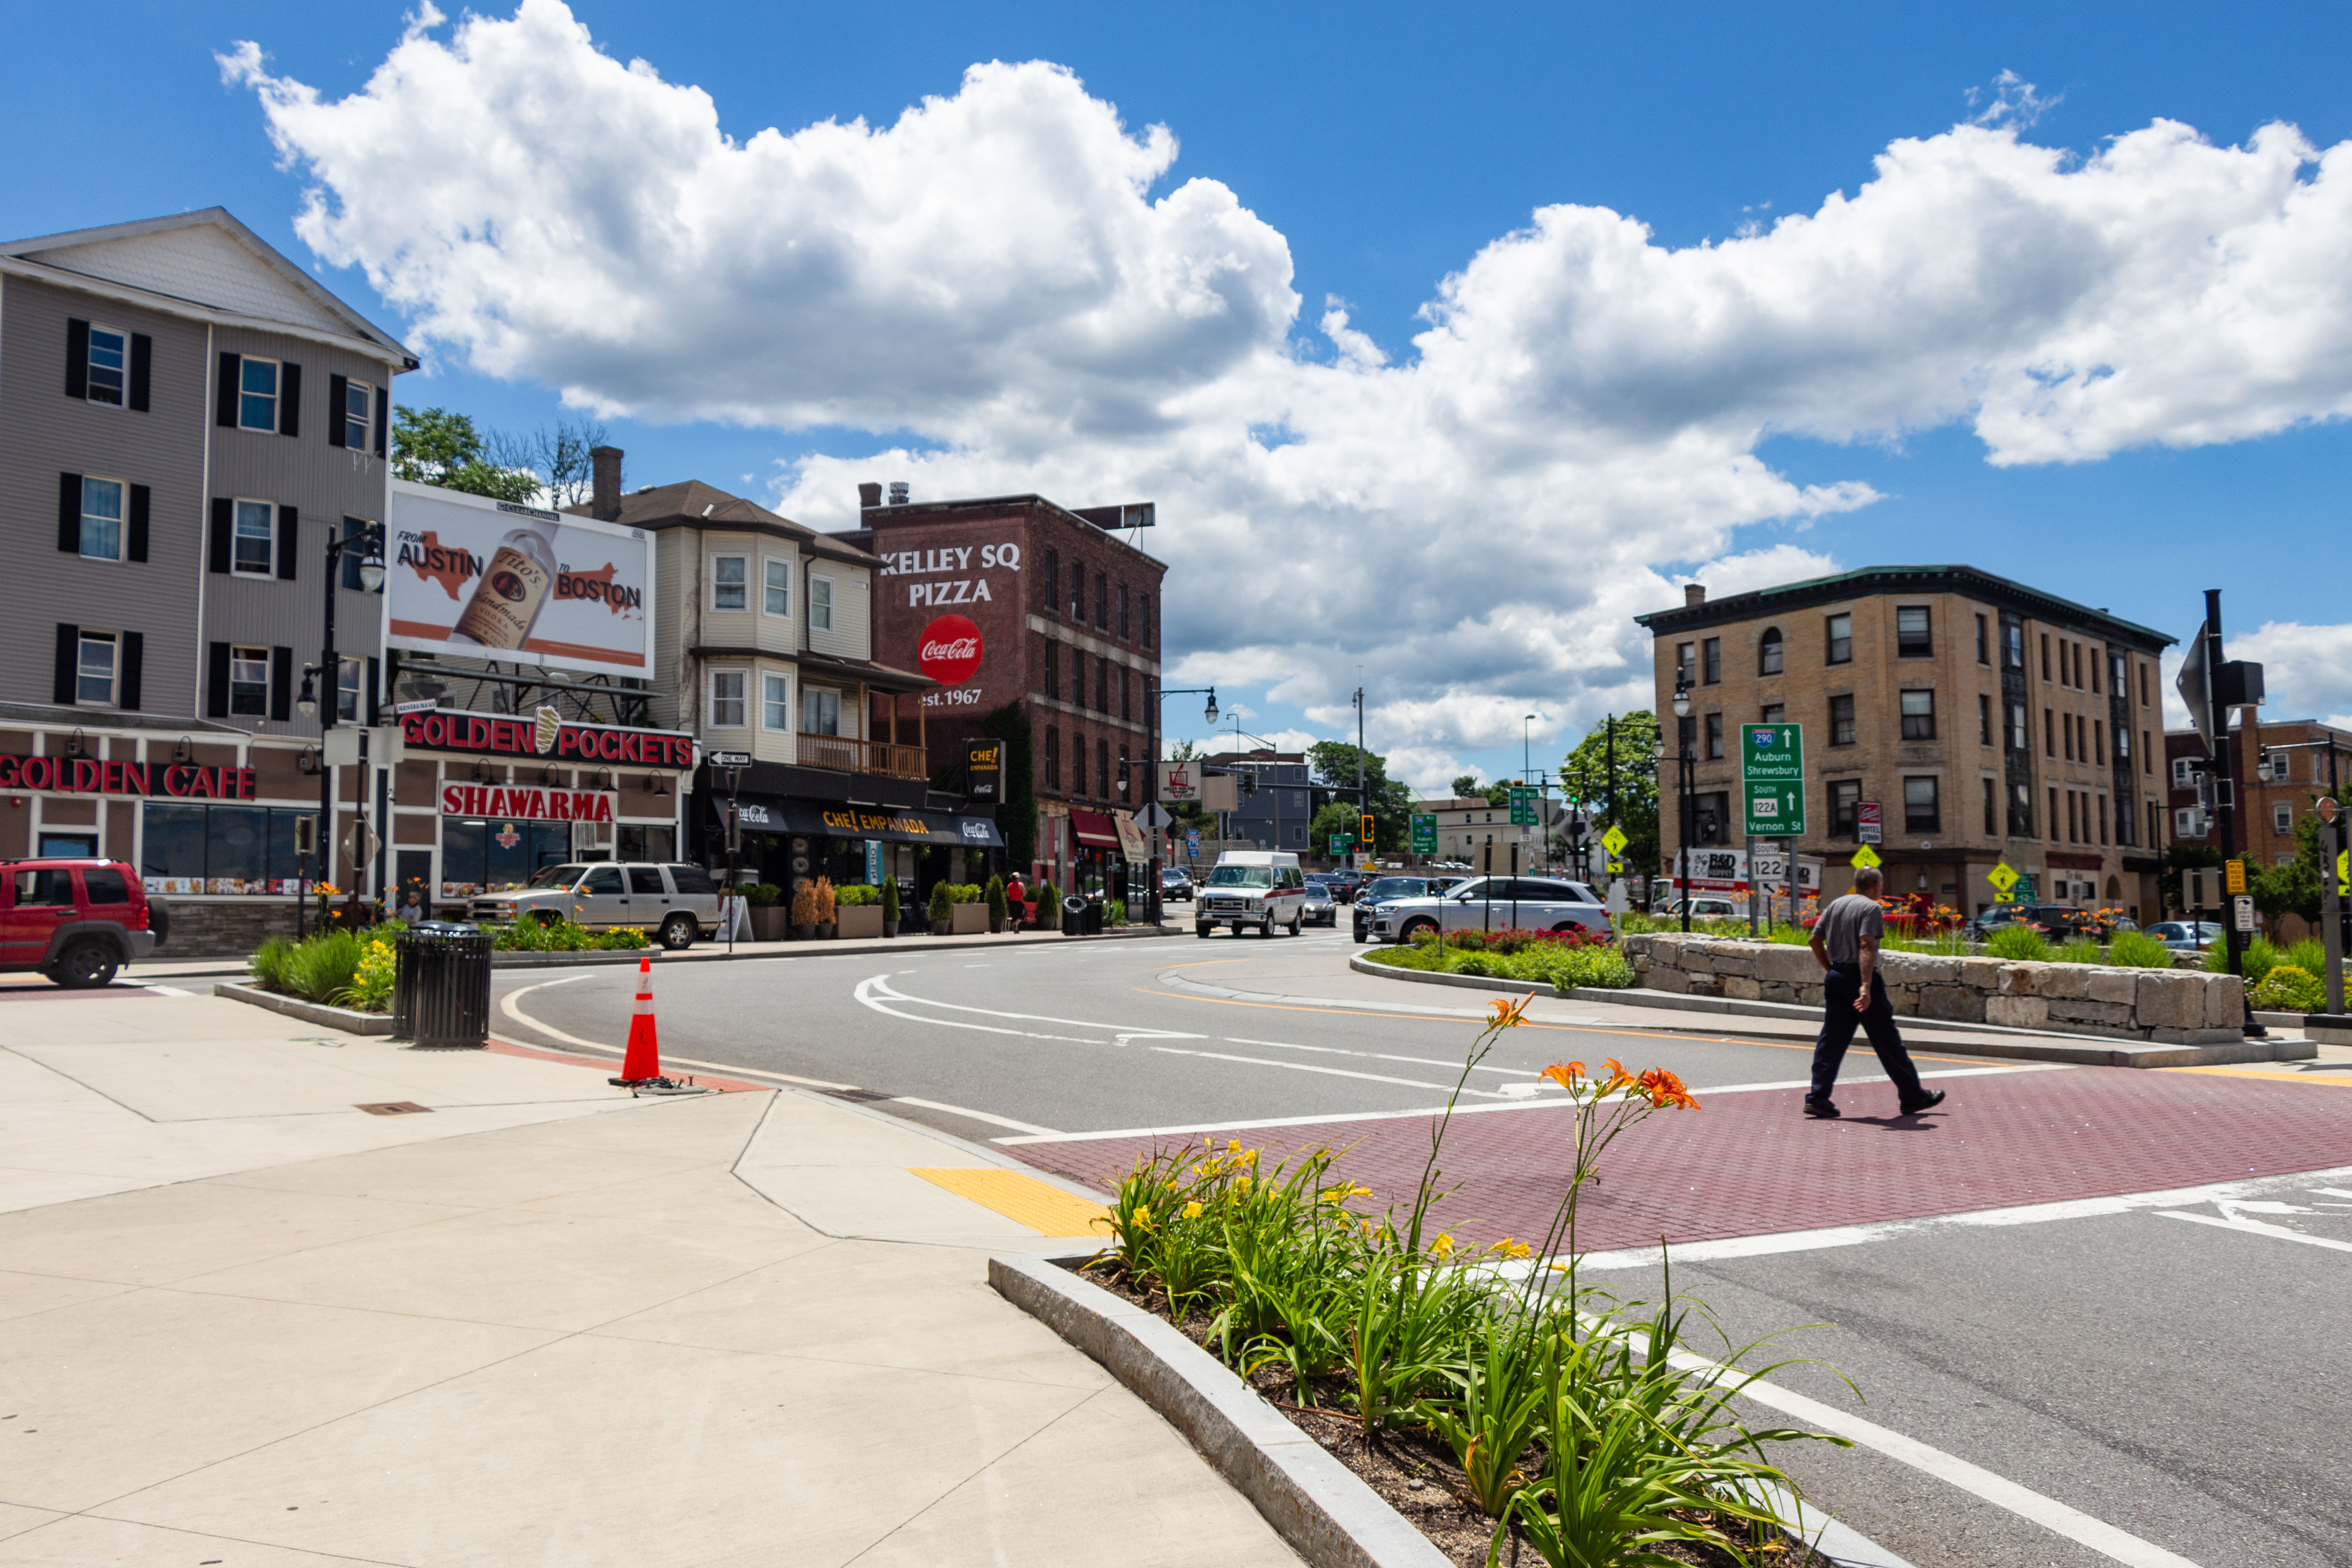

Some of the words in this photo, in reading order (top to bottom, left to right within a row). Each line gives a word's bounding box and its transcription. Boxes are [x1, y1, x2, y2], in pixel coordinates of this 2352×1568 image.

[397, 530, 427, 543] FROM
[397, 543, 483, 577] AUSTIN
[880, 546, 973, 576] KELLEY
[981, 543, 1021, 572] SQ
[559, 563, 570, 573] TO
[558, 574, 640, 609] BOSTON
[909, 578, 992, 607] PIZZA
[475, 591, 527, 631] Handmade
[480, 607, 509, 630] VODKA
[921, 637, 979, 662] Coca-Cola
[944, 689, 982, 705] 1967
[399, 701, 435, 711] RESTAURANT
[399, 713, 535, 754] GOLDEN
[558, 727, 693, 765] POCKETS
[1756, 734, 1772, 744] 290
[970, 747, 998, 764] CHE!
[1754, 752, 1791, 761] Auburn
[0, 754, 150, 794] GOLDEN
[163, 764, 255, 799] CAFE
[1747, 766, 1799, 777] Shrewsbury
[1754, 785, 1776, 794] SOUTH
[443, 785, 613, 822] SHAWARMA
[1755, 803, 1777, 813] 122A
[823, 810, 859, 833] CHE!
[859, 814, 929, 834] EMPANADA
[1749, 822, 1784, 831] Vernon
[1791, 821, 1801, 831] St
[1861, 825, 1881, 833] HOTEL
[1756, 845, 1779, 853] SOUTH
[1709, 853, 1736, 869] B&D
[1754, 861, 1782, 875] 122
